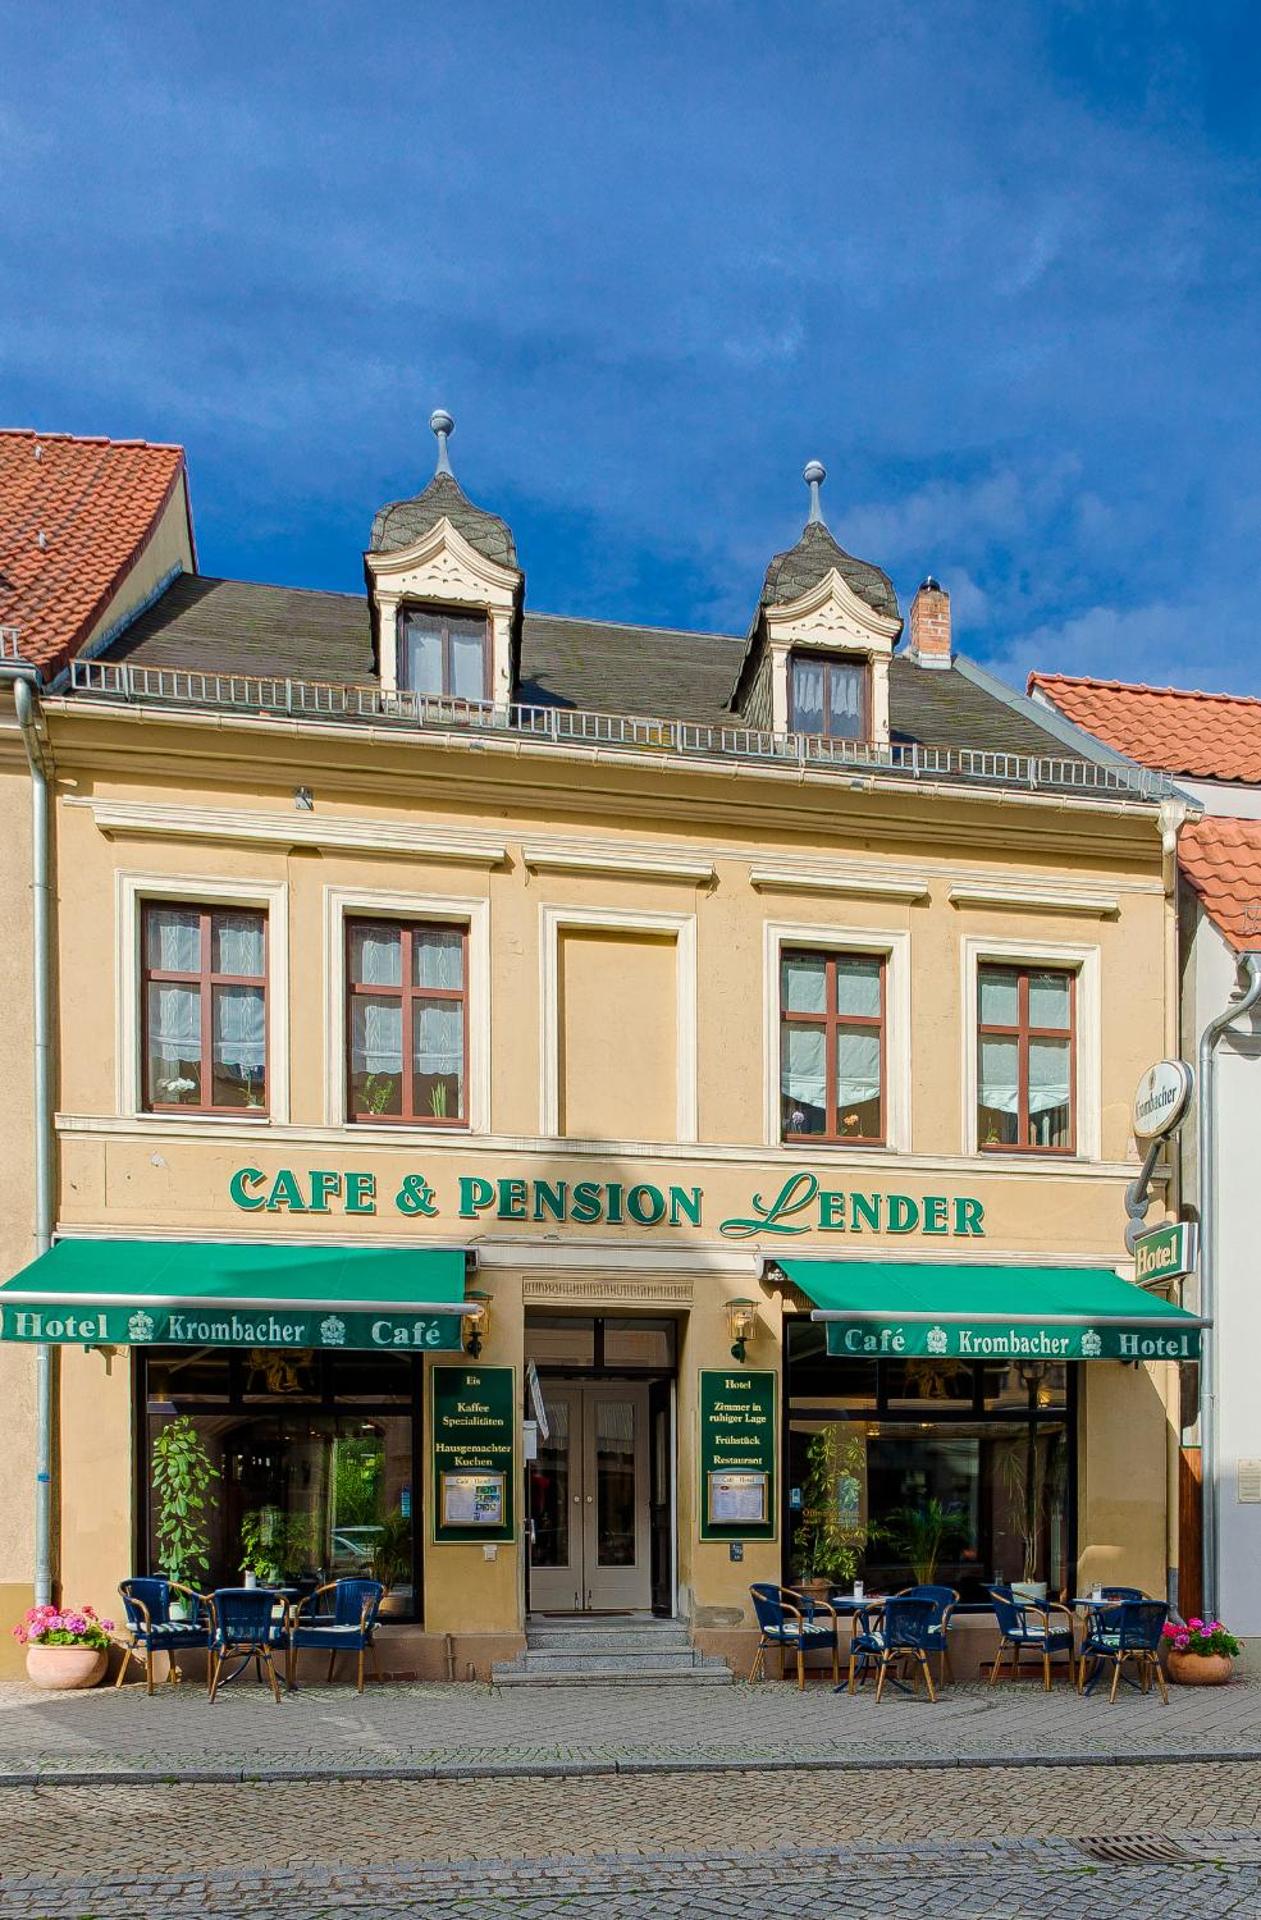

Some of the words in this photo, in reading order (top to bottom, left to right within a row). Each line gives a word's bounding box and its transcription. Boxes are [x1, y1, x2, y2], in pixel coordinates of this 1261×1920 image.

[229, 1167, 376, 1214] CAFE
[395, 1174, 440, 1217] &
[458, 1176, 702, 1227] PENSION
[718, 1171, 985, 1238] LENDER
[1137, 1234, 1177, 1276] Hotel
[15, 1312, 109, 1338] Hotel
[168, 1315, 305, 1342] Krombacher
[371, 1321, 440, 1345] Café
[844, 1328, 906, 1351] Café
[958, 1330, 1069, 1354] Krombacher
[1119, 1334, 1189, 1356] Hotel
[466, 1376, 481, 1385] Eis
[725, 1380, 751, 1389] Hotel
[457, 1402, 490, 1413] Kaffee
[714, 1402, 750, 1411] Zimmer
[752, 1403, 762, 1411] in
[442, 1416, 504, 1428] Spezialitäten
[709, 1413, 742, 1424] ruhiger
[744, 1413, 766, 1425] Lage
[715, 1435, 760, 1445] Frühstück
[435, 1443, 512, 1454] Hausgemachter
[454, 1457, 493, 1466] Kuchen
[713, 1455, 762, 1465] Restaurant
